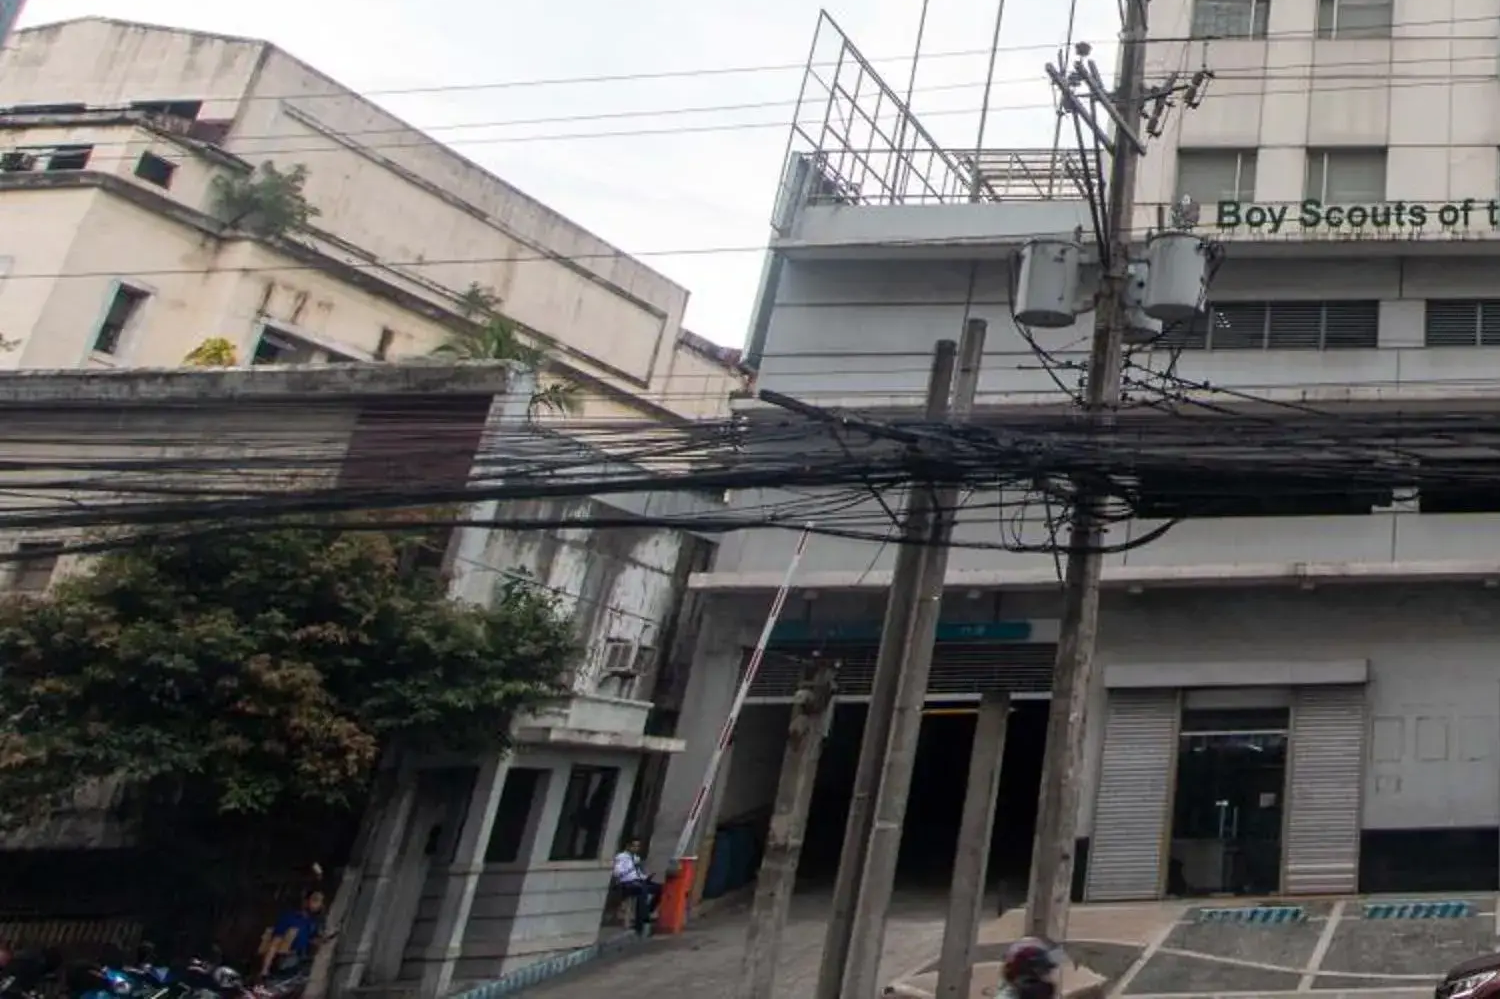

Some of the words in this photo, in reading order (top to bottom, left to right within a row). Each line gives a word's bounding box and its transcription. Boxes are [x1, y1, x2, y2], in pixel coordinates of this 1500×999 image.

[1216, 199, 1286, 232] Boy
[1300, 199, 1427, 228] Scouts
[1438, 198, 1472, 227] of
